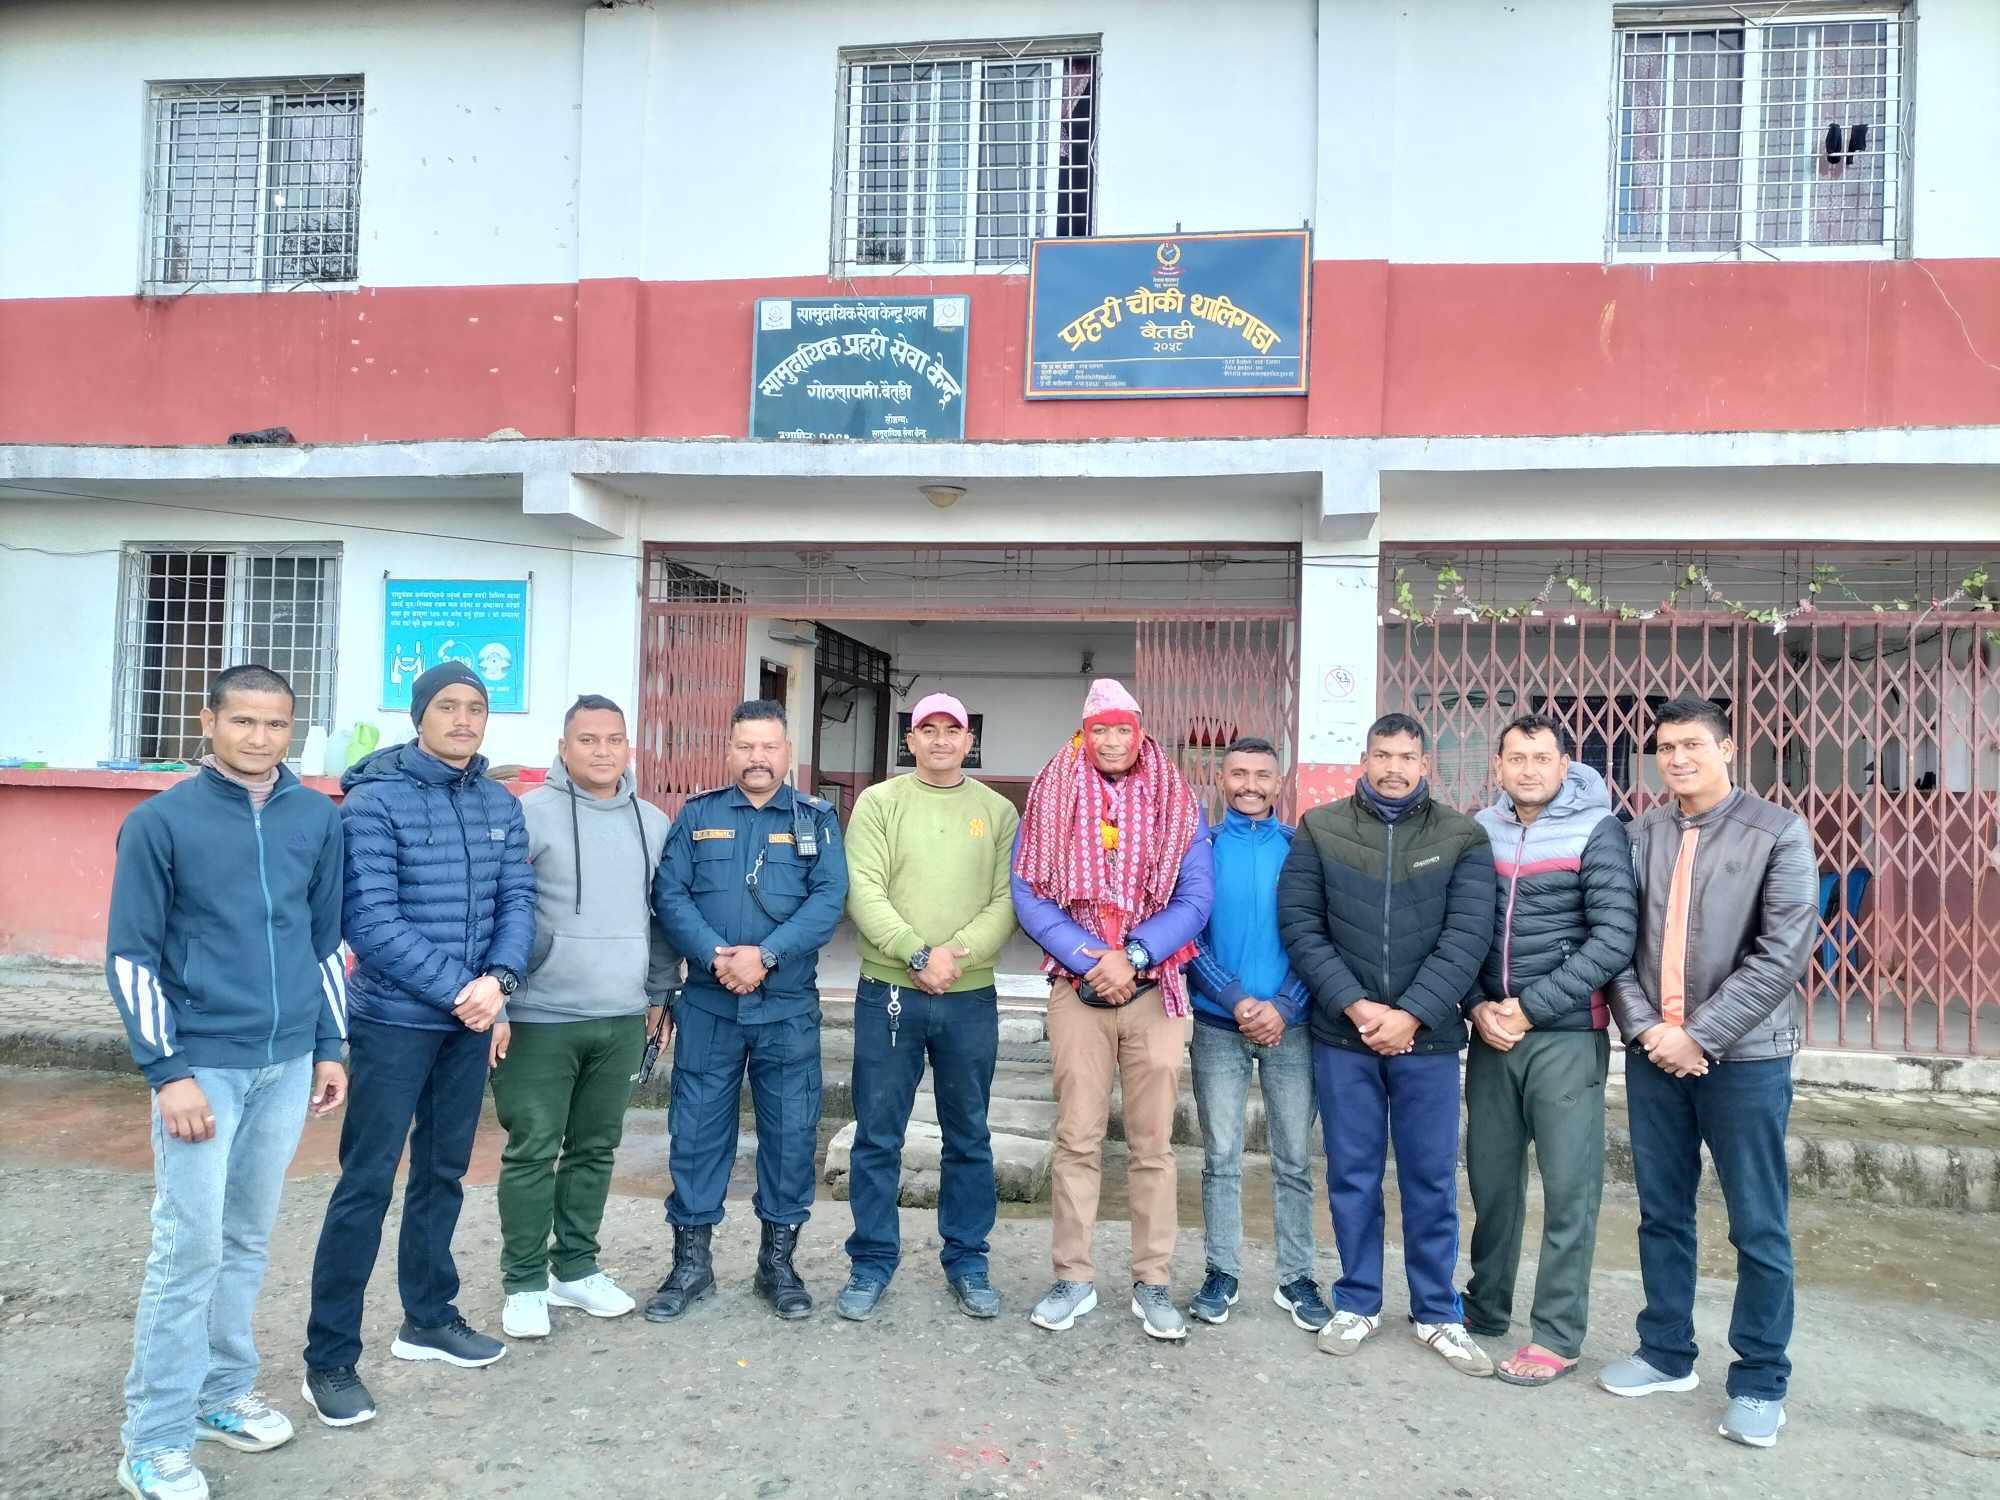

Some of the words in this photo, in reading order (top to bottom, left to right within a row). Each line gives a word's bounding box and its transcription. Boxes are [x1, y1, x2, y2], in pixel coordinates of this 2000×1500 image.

[796, 303, 857, 326] सामुदायिक
[856, 302, 880, 324] सेवा
[1057, 296, 1122, 352] प्रहरी
[1125, 286, 1186, 314] चौकी
[1139, 319, 1195, 339] बैतडी
[758, 336, 841, 398] सामुदायिक
[841, 327, 889, 361] प्रहरी
[889, 332, 931, 375] सेवा
